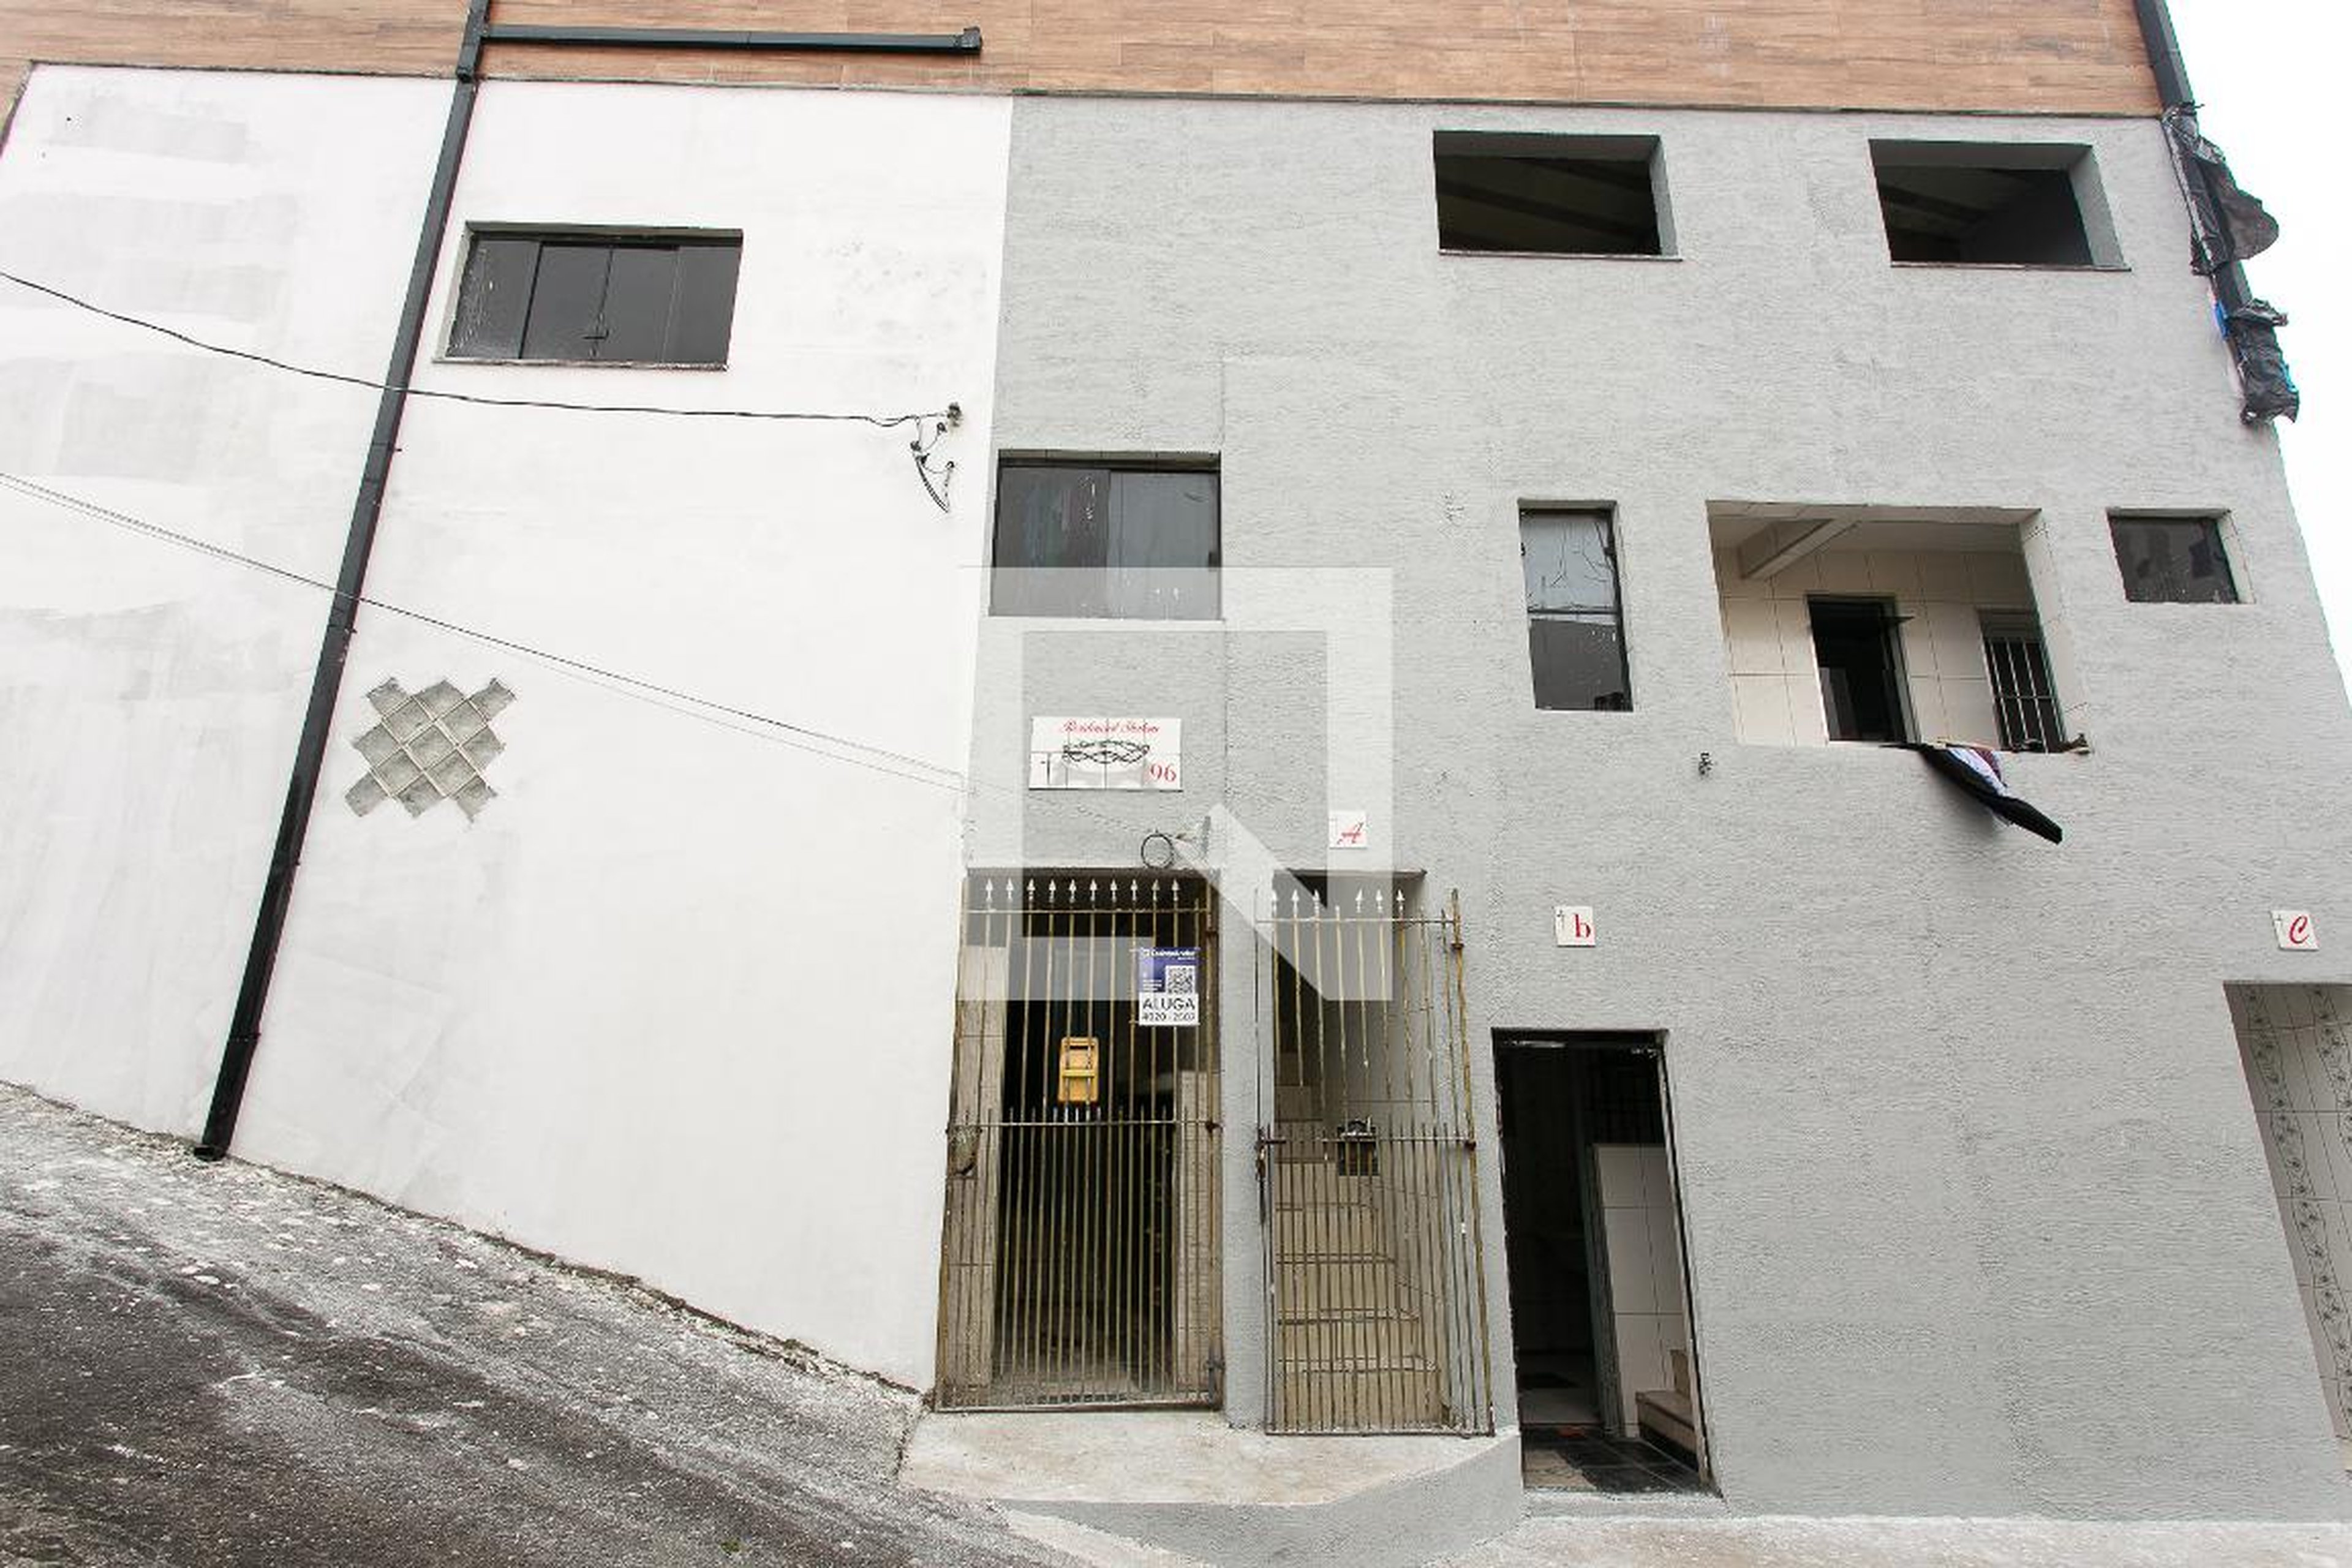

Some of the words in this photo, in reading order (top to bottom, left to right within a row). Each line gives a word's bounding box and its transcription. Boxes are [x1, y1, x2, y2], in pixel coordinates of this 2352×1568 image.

[1150, 763, 1177, 783] 96
[1336, 821, 1364, 845] A
[1573, 912, 1591, 938] b
[1142, 997, 1196, 1011] ALUGA
